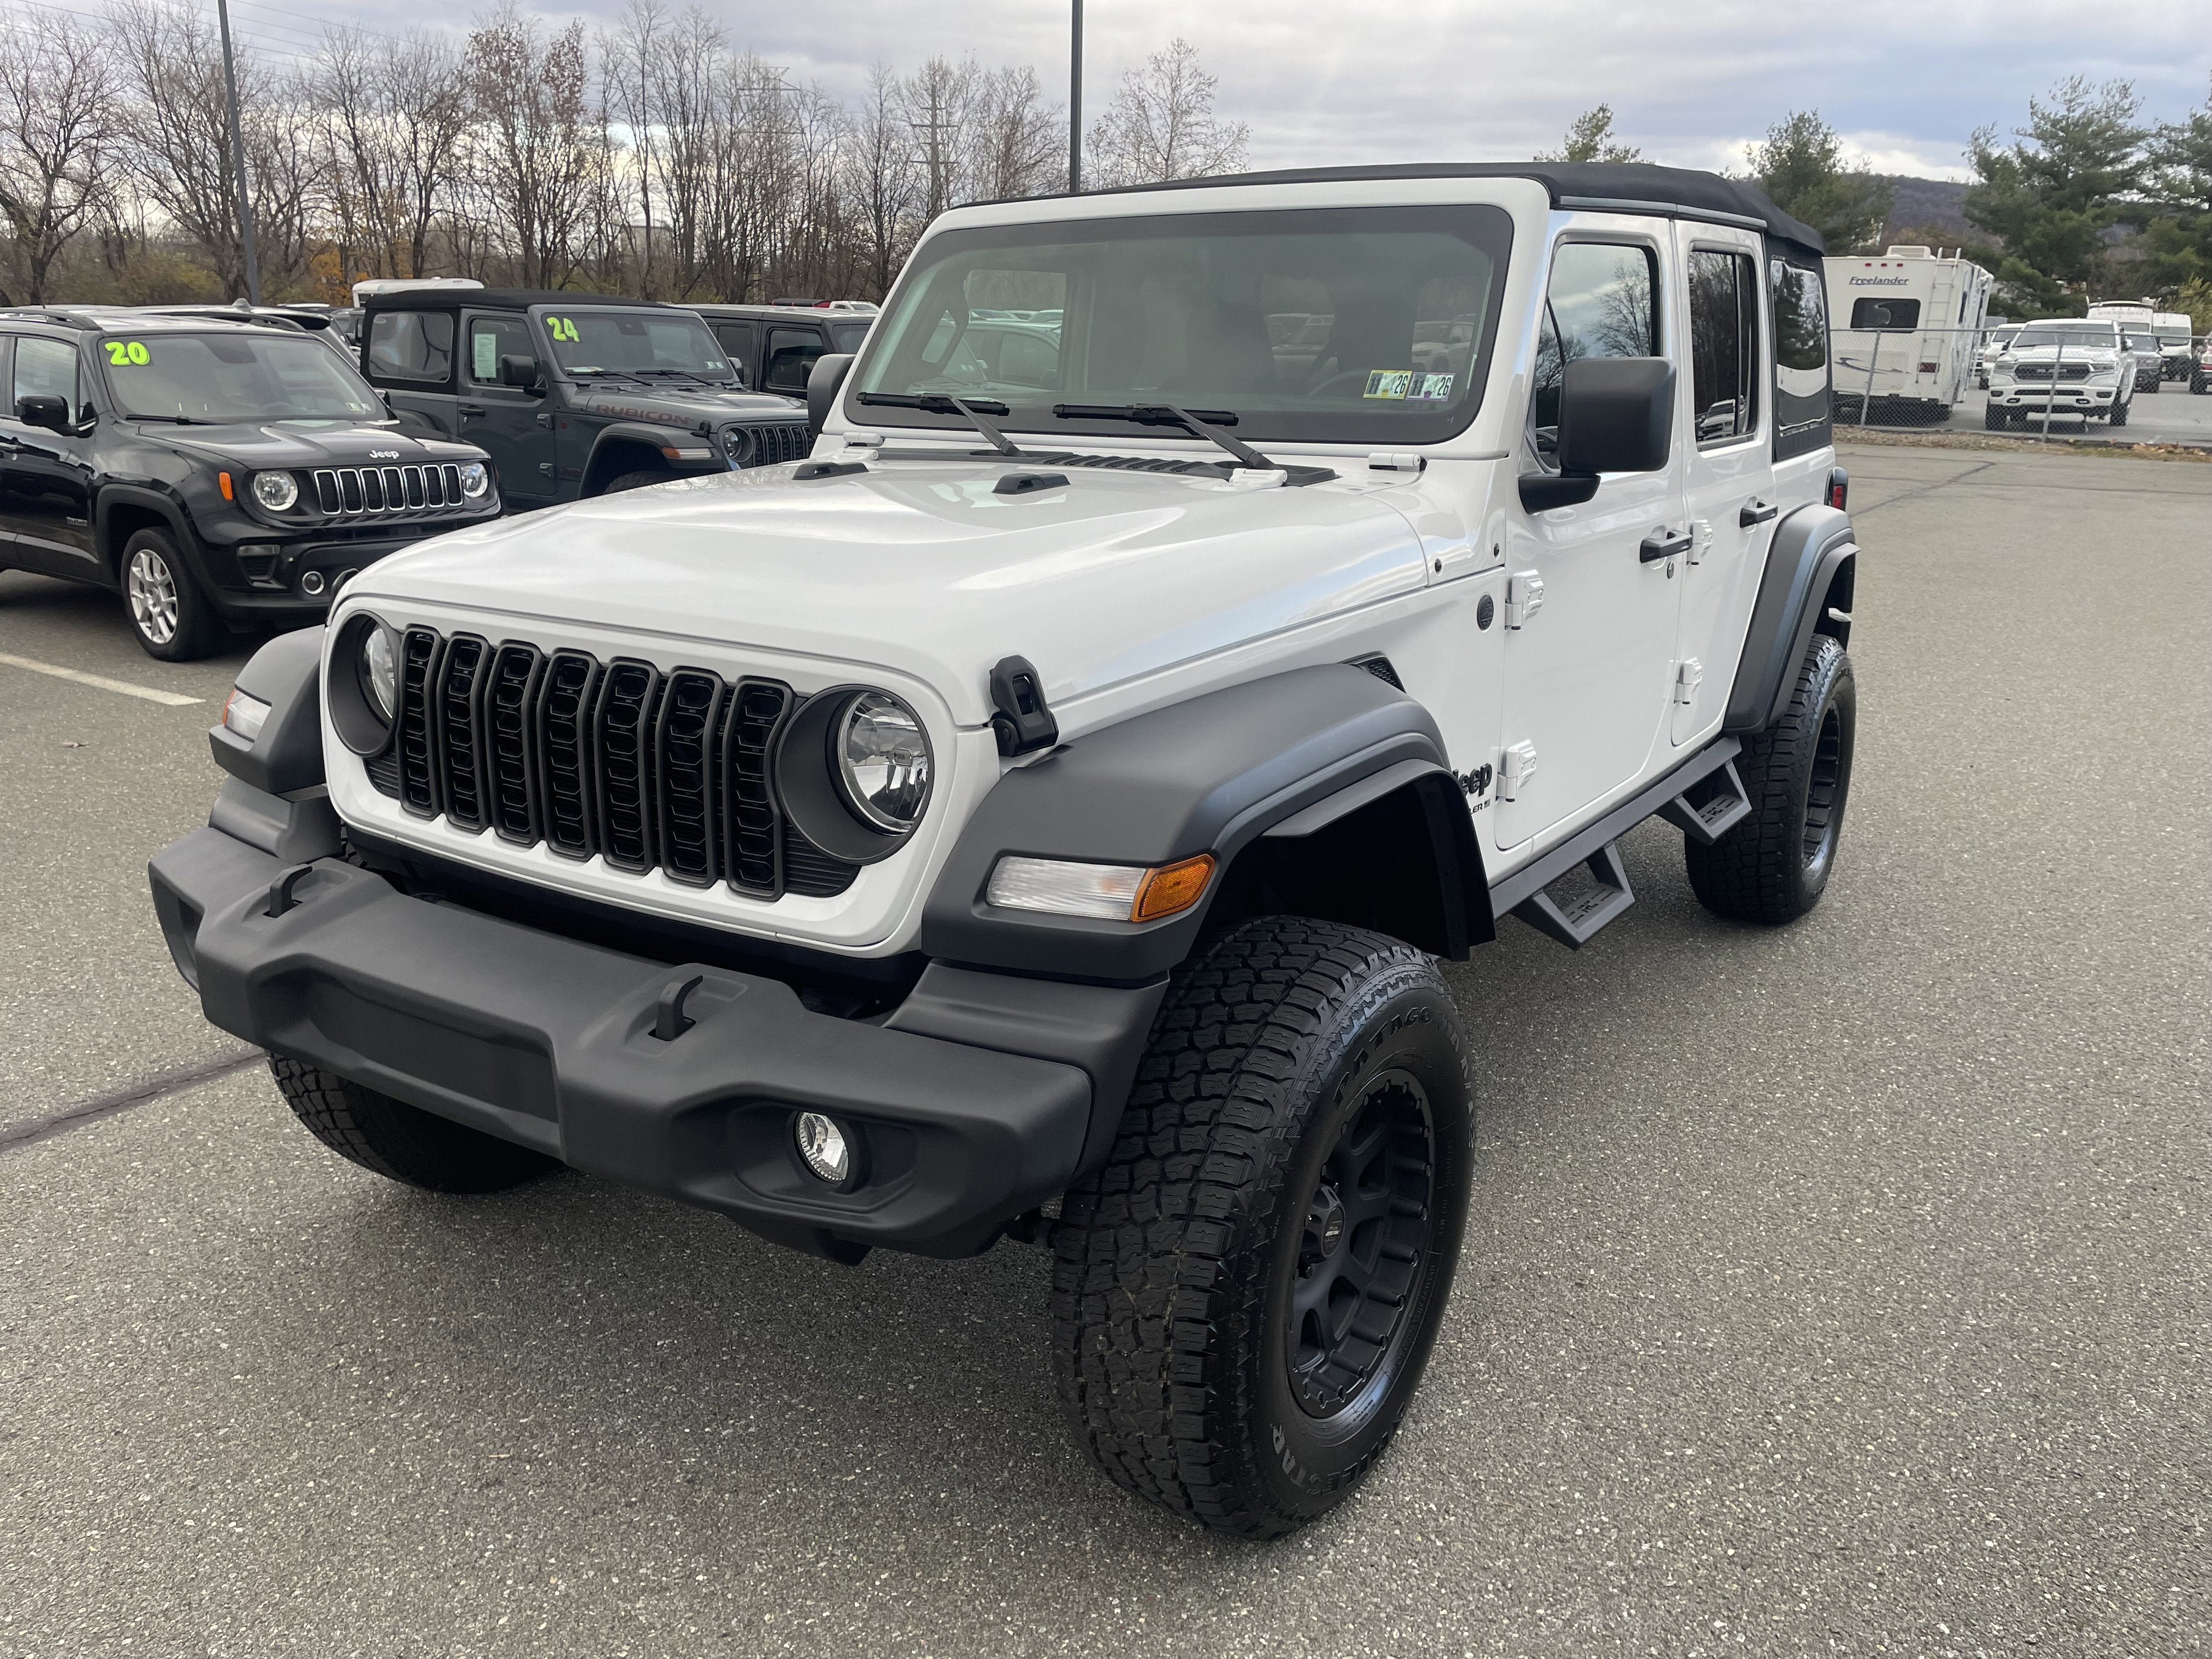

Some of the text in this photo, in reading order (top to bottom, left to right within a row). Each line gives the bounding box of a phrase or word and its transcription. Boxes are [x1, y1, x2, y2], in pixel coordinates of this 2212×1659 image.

[1849, 276, 1910, 285] Freelander
[546, 317, 580, 342] 24
[105, 341, 150, 366] 20
[1394, 375, 1408, 394] 26
[1437, 376, 1452, 396] 26
[595, 403, 690, 425] RUBICON
[369, 450, 400, 459] Jeep
